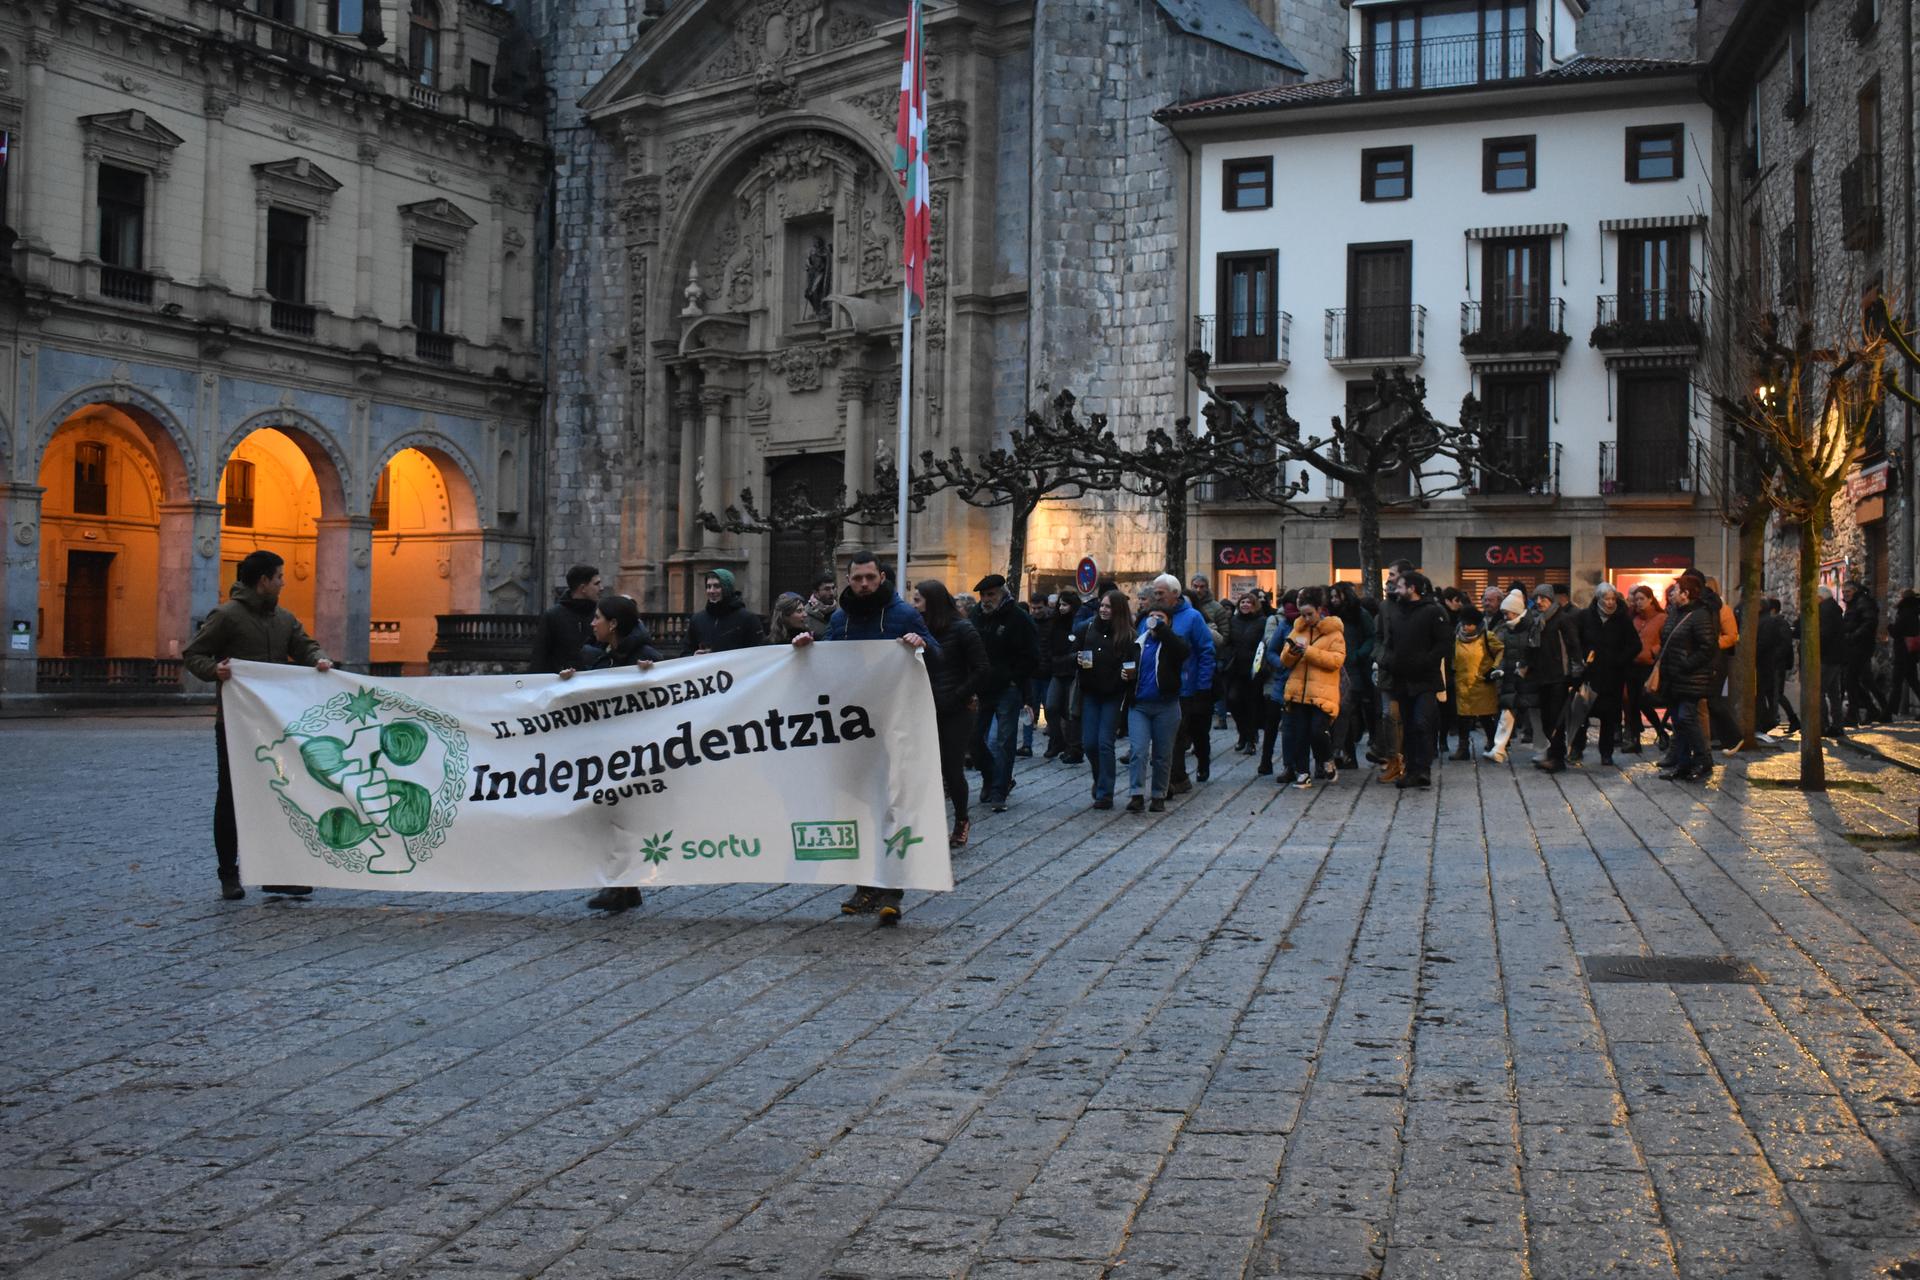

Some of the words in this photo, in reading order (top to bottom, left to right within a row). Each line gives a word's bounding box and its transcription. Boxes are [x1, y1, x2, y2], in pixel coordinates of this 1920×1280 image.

[1218, 547, 1273, 565] GAES
[1485, 545, 1545, 565] GAES
[517, 670, 734, 736] BURUNTZALDEAKO
[470, 696, 876, 801] Independentzia
[593, 778, 667, 806] eguna
[681, 834, 761, 860] sortu
[795, 826, 855, 848] LAB
